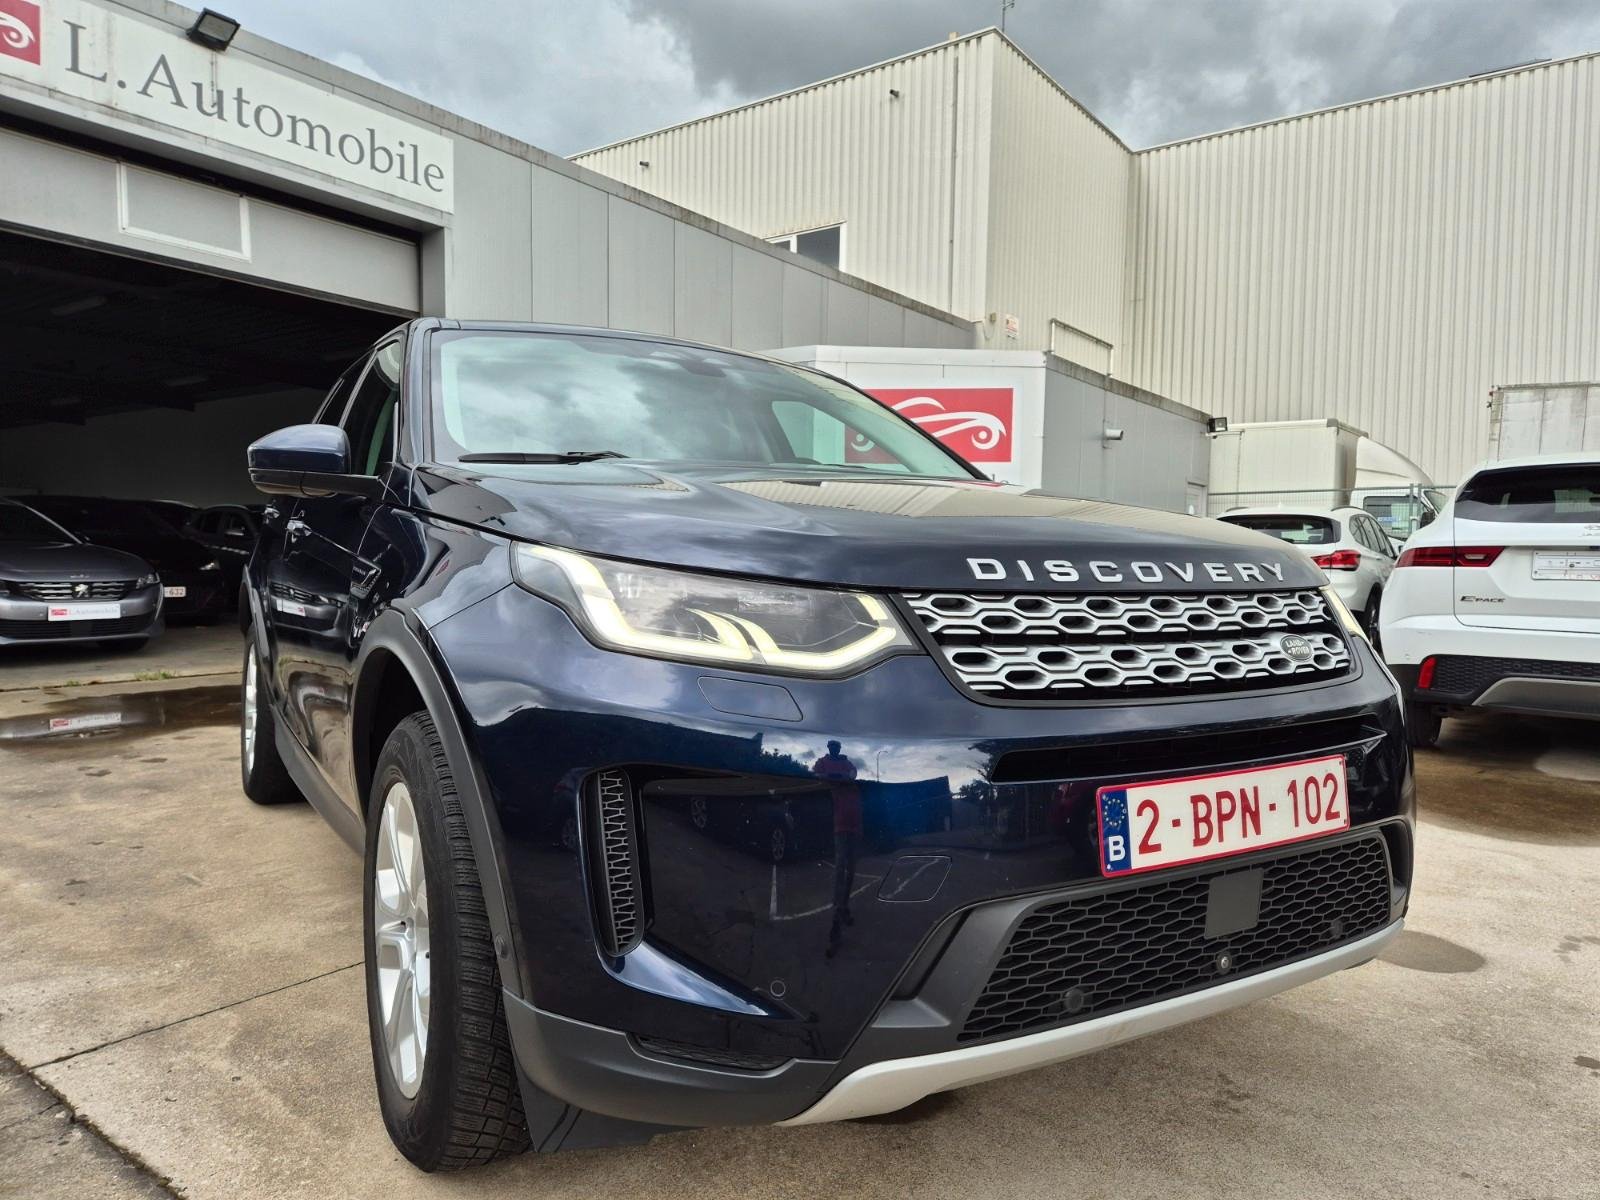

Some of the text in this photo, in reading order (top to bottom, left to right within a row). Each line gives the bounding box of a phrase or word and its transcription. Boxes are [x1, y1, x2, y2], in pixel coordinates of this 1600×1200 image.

[63, 19, 445, 193] L.Automobile
[966, 557, 1285, 583] DISCOVERY
[1285, 639, 1302, 648] LAND
[1291, 646, 1310, 655] ROVER
[1136, 772, 1341, 855] 2-BPN-102
[1108, 835, 1126, 862] B
